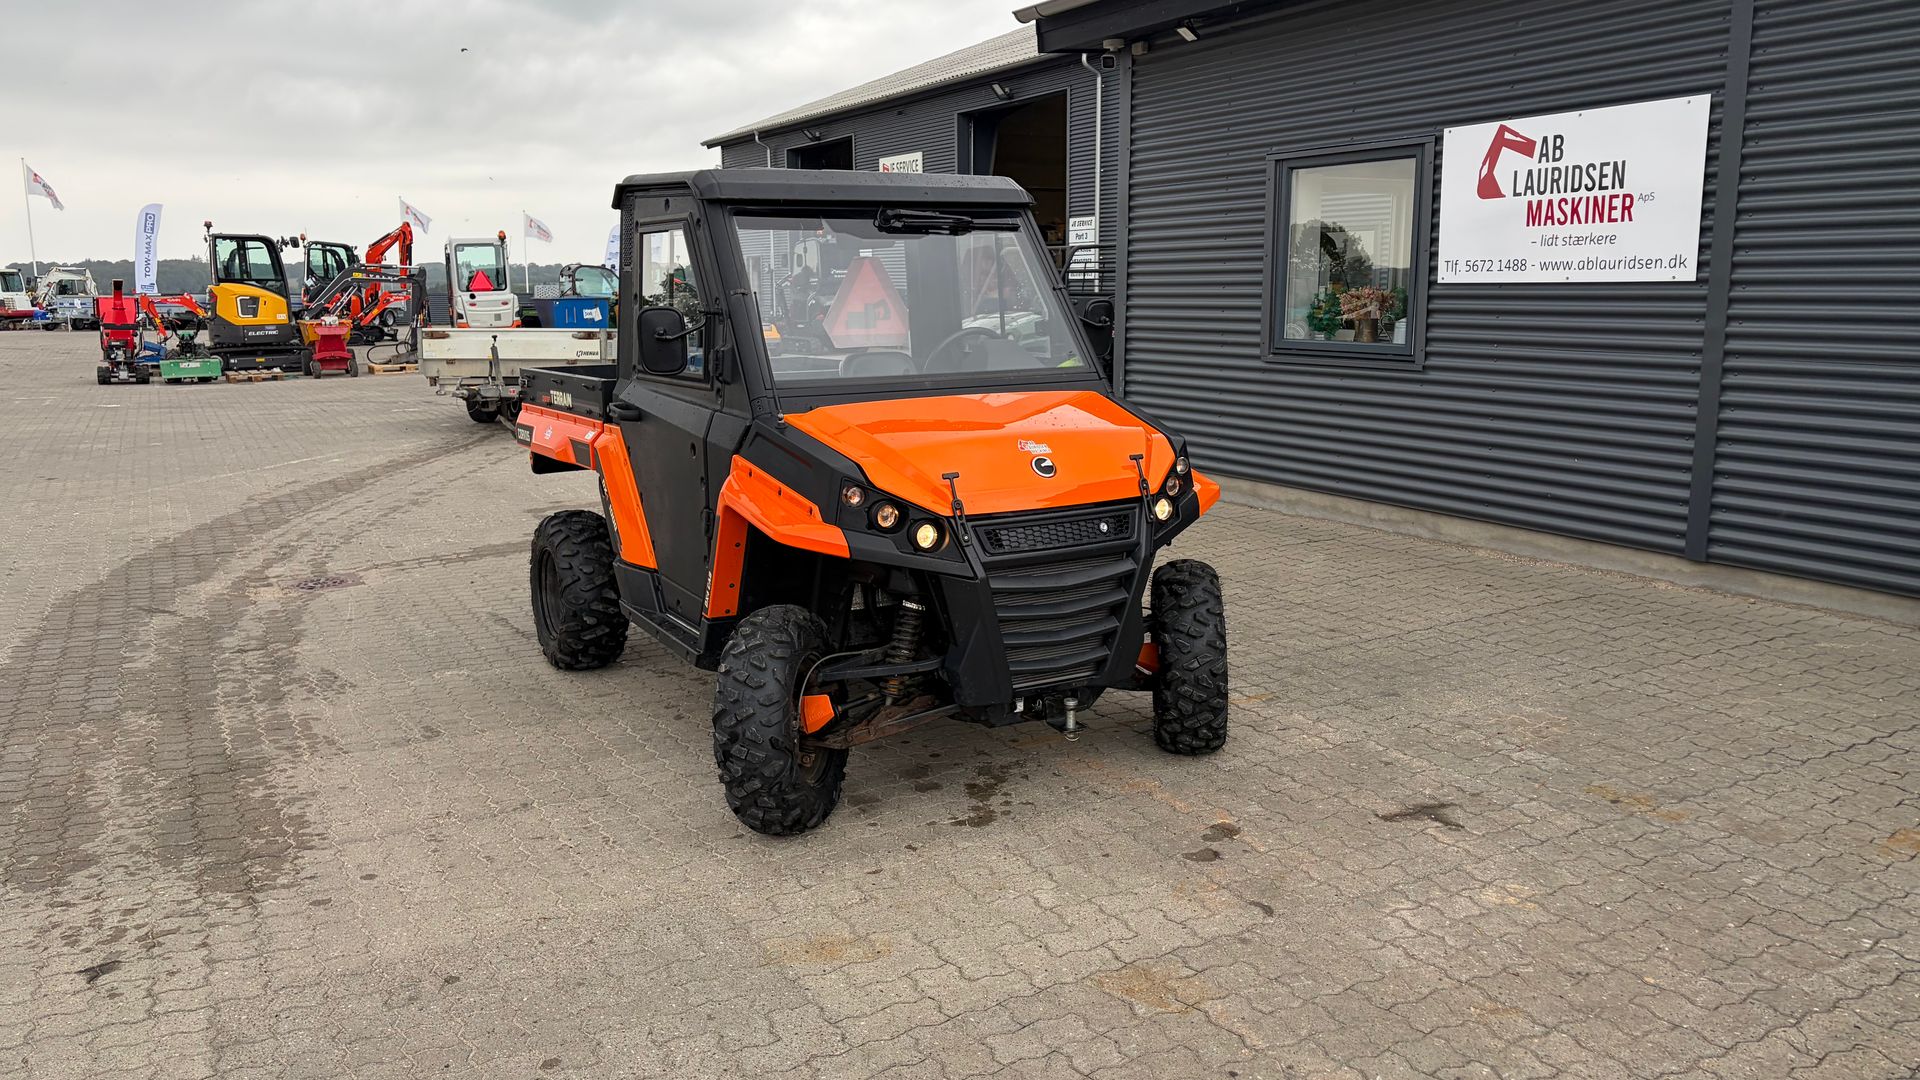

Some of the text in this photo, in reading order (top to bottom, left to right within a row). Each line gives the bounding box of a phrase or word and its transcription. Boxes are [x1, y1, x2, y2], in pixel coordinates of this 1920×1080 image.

[1538, 134, 1565, 164] AB
[1512, 160, 1627, 198] LAURIDSEN
[1525, 191, 1656, 228] MASKINER ApS
[144, 214, 154, 279] TOW-MAX PRO
[1540, 234, 1560, 248] lidt
[1561, 232, 1617, 247] stærkere
[1444, 260, 1462, 276] Tlf.
[1465, 259, 1494, 273] 5672
[1496, 258, 1528, 273] 1488
[1539, 253, 1688, 272] www.ablauridsen.dk
[549, 389, 573, 408] TERRAIN
